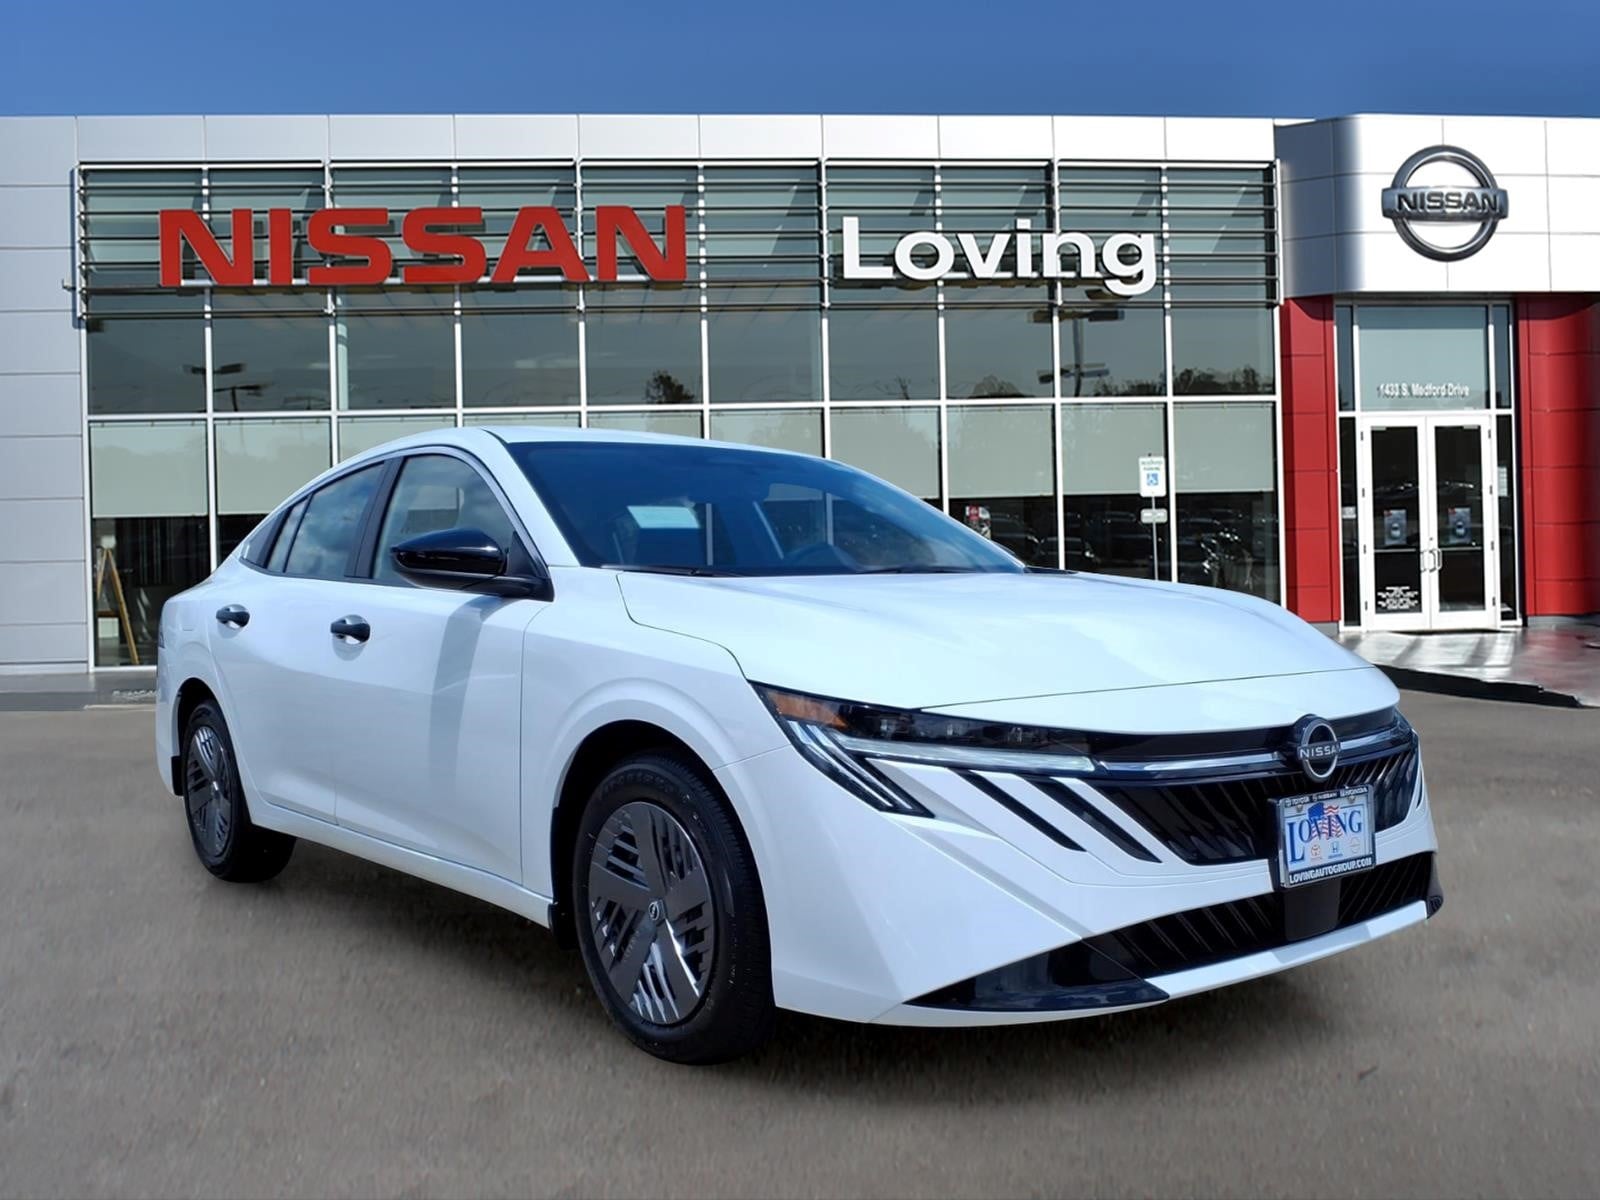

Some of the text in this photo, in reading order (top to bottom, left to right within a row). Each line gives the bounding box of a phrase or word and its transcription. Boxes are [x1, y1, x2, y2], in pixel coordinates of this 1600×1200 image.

[1396, 191, 1498, 212] NISSAN
[158, 205, 688, 287] NISSAN
[841, 216, 1158, 296] Loving
[1411, 383, 1446, 397] Medford
[1447, 383, 1470, 397] Drive
[1287, 810, 1363, 863] LOVING
[1289, 856, 1373, 884] LOVINGAUTOGROUP.COM
